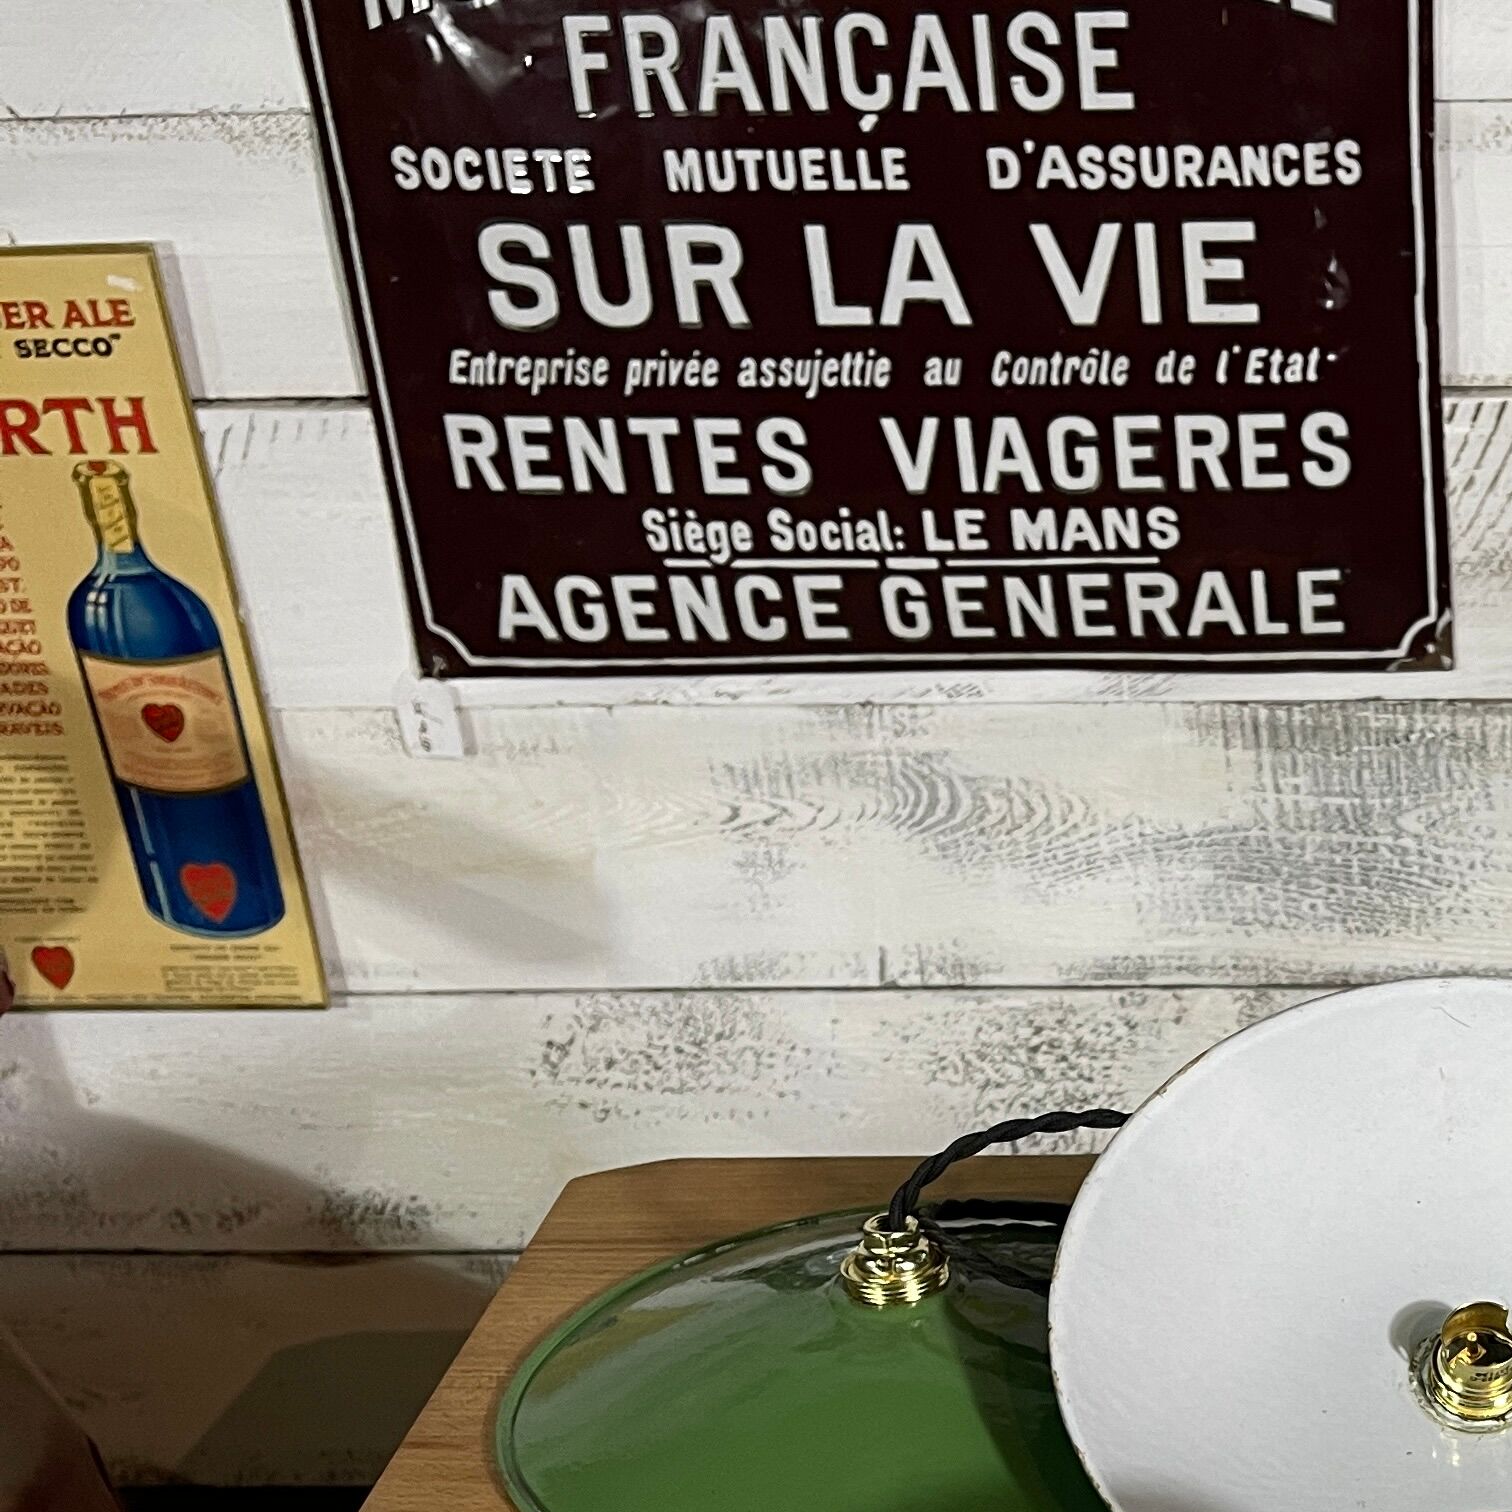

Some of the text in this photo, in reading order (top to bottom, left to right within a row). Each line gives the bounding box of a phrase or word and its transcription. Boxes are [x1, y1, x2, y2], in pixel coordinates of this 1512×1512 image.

[562, 11, 1135, 132] FRANÇAISE
[391, 139, 1362, 194] SOCIETE MUTUELLE D'ASSURANCES
[478, 220, 1260, 328] SUR LA VIE
[0, 298, 136, 329] ER ALE
[449, 349, 610, 395] Entreprise
[624, 349, 719, 396] privée
[737, 347, 891, 398] assujettie
[923, 356, 962, 386] au
[991, 348, 1130, 386] Contrôle
[1155, 349, 1196, 386] de
[0, 396, 159, 455] RTH
[443, 412, 1351, 495] RENTES VIAGERES
[642, 507, 1180, 563] Siège Social: LE MANS
[500, 569, 1344, 642] AGENCE GENERALE
